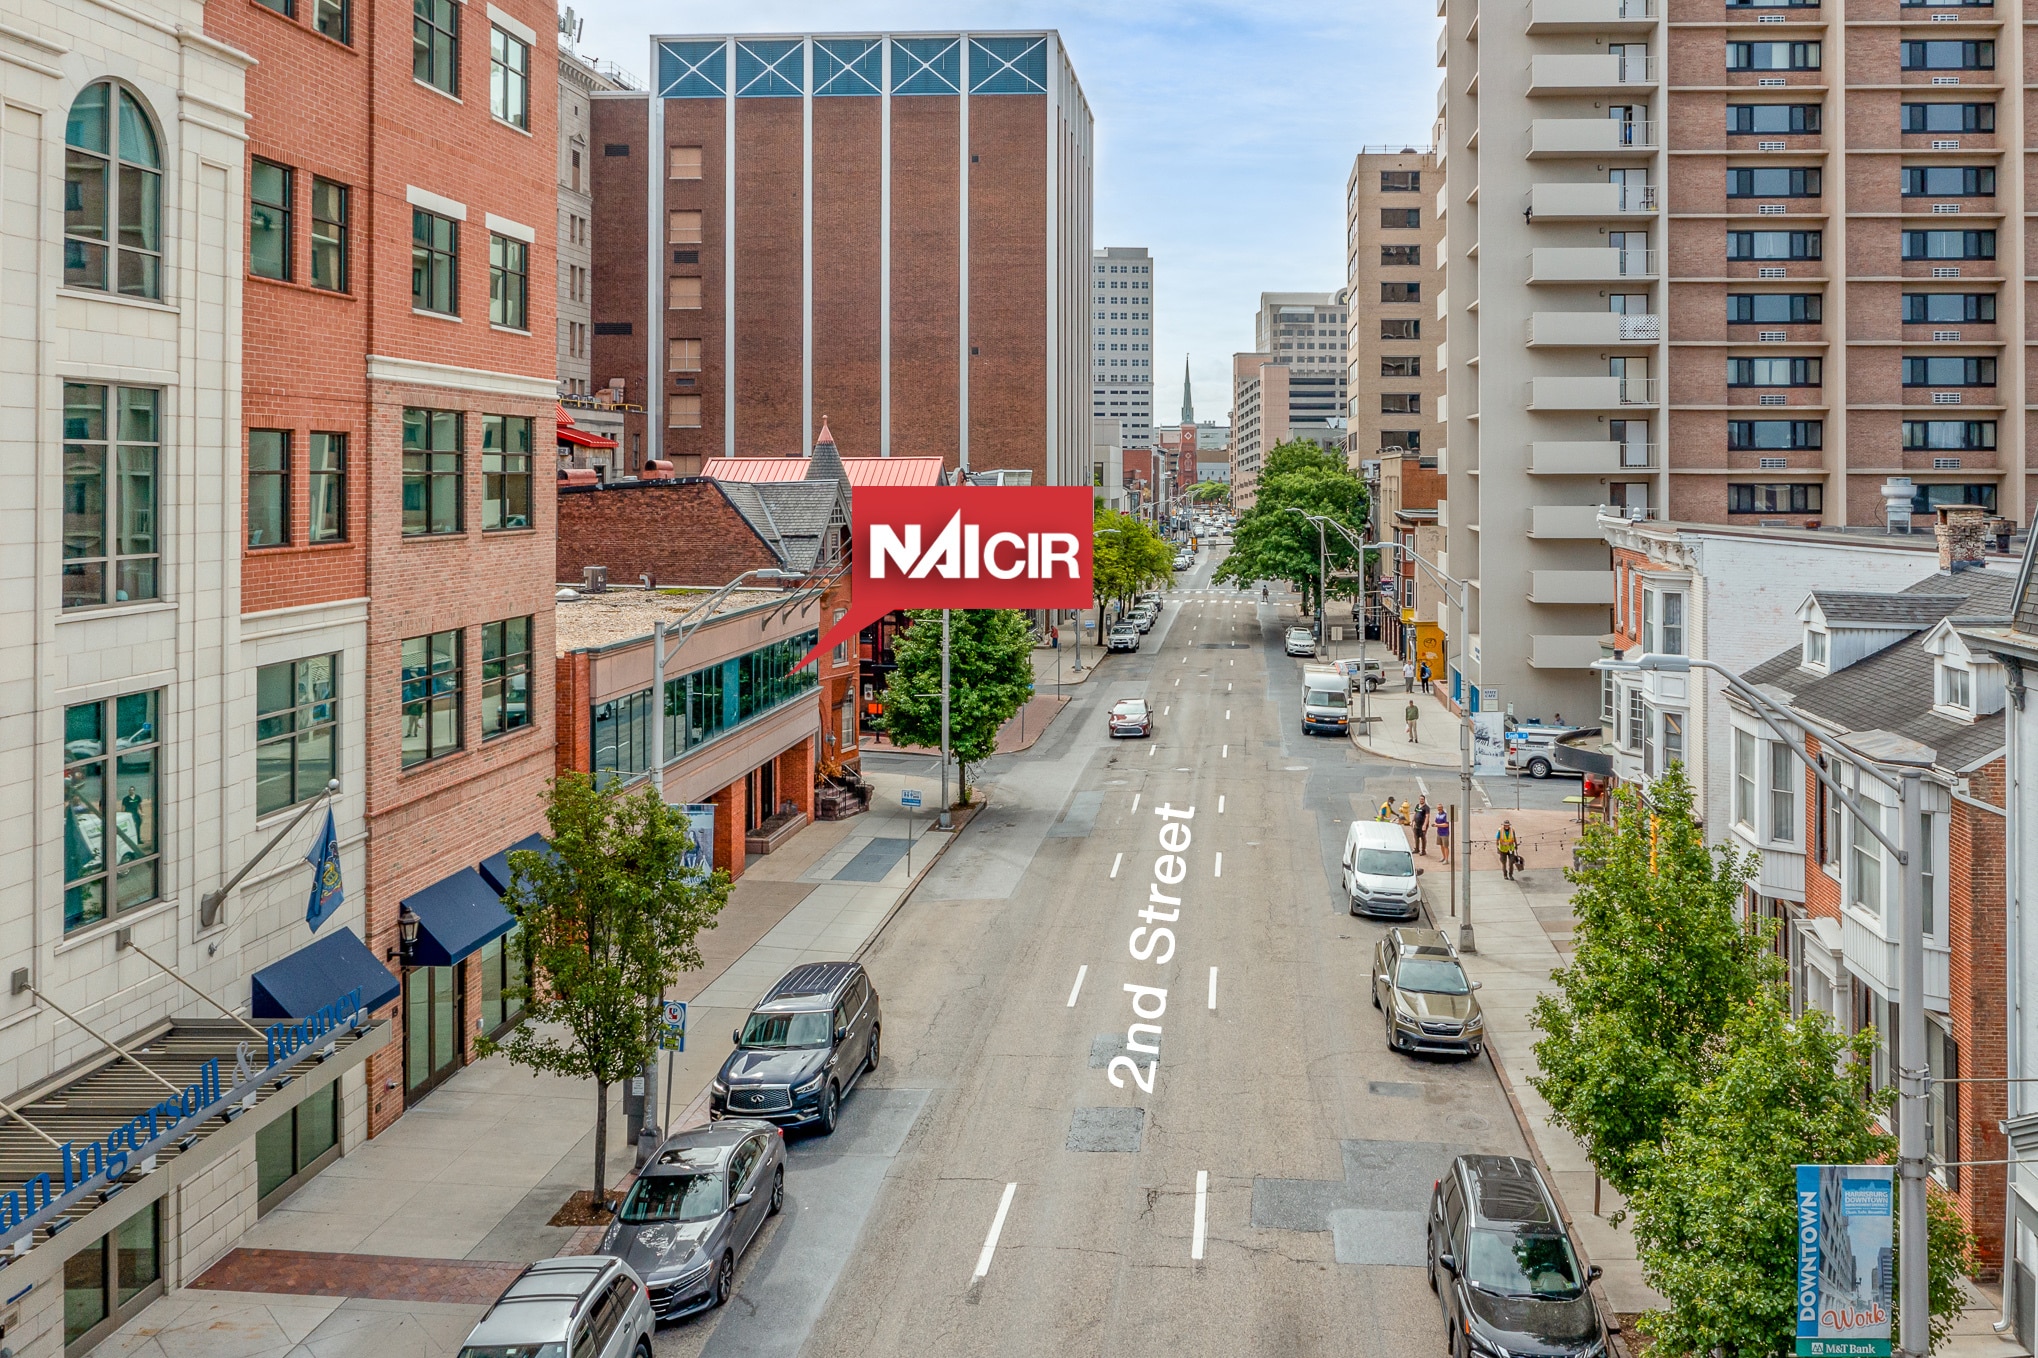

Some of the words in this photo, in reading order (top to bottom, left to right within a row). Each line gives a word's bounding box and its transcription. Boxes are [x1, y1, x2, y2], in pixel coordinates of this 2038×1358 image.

[58, 1056, 223, 1197] Ingersoll
[231, 1040, 257, 1089] &
[264, 985, 364, 1071] Rooney
[1800, 1191, 1817, 1321] DOWNTOWN
[1821, 1303, 1886, 1330] Work
[1825, 1344, 1848, 1354] M&T
[1849, 1343, 1876, 1354] Bank
